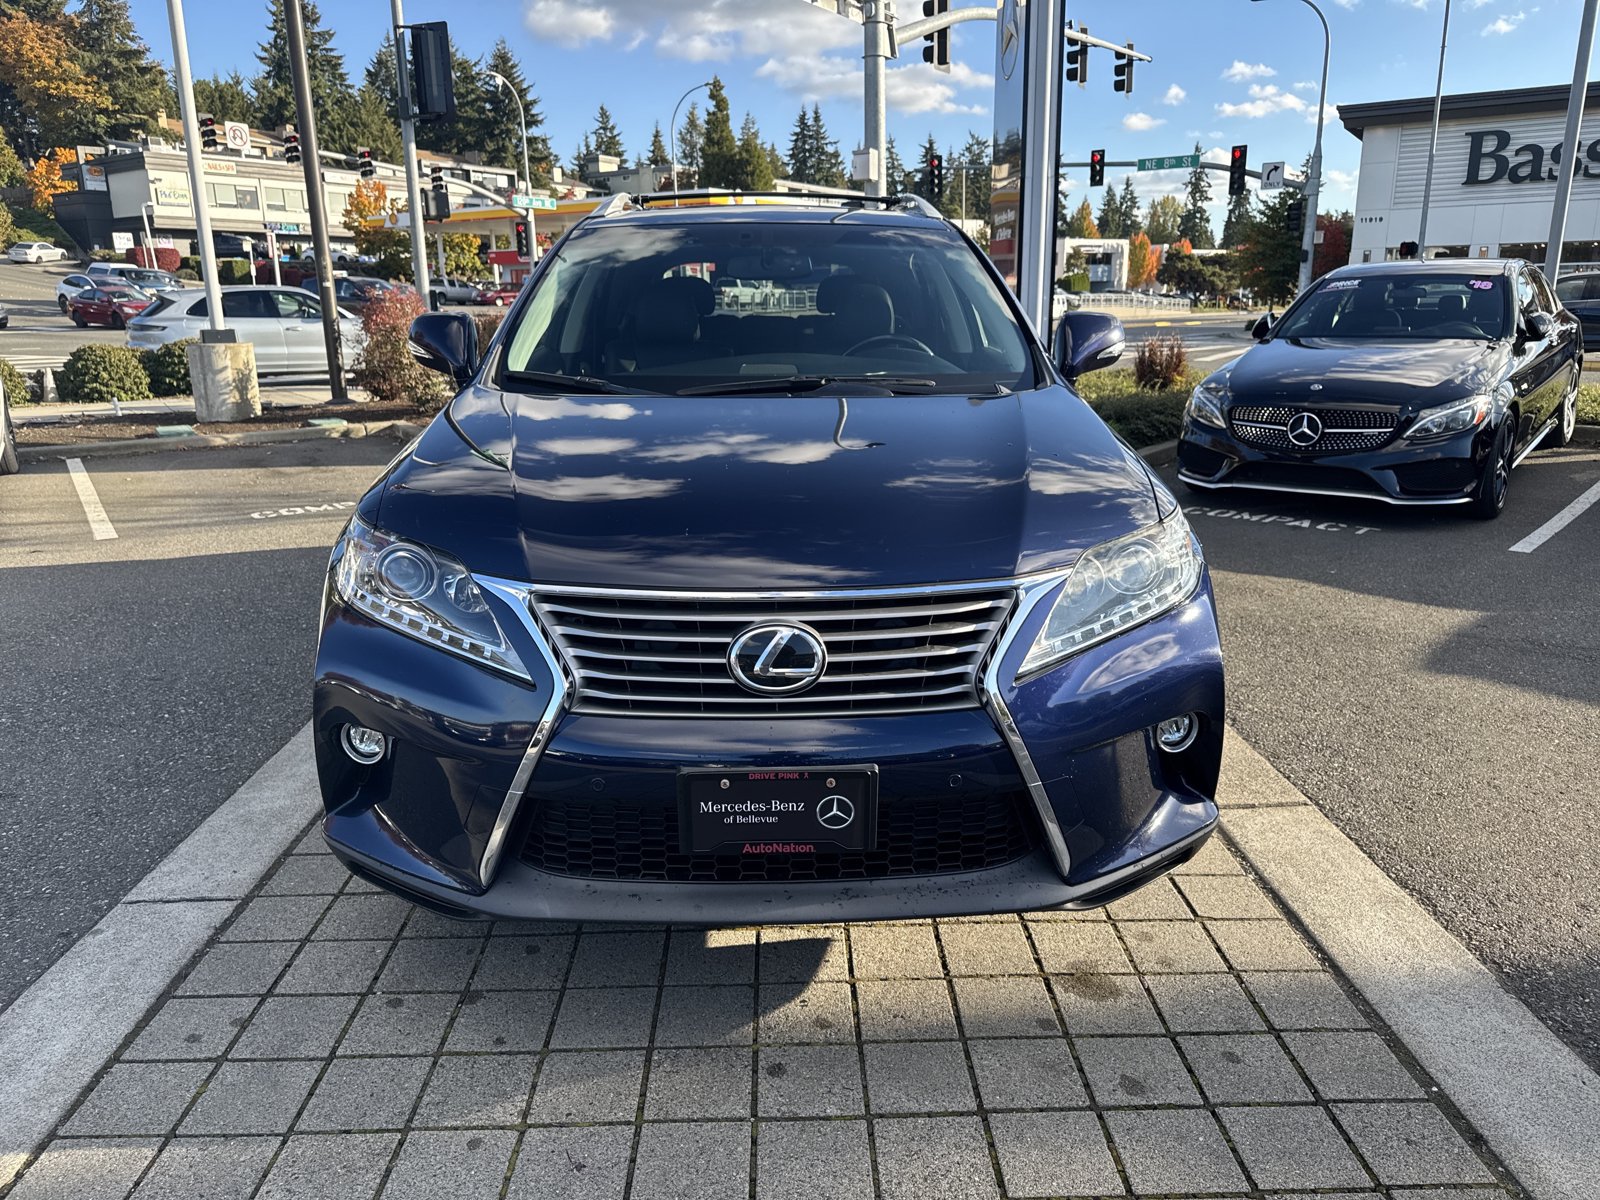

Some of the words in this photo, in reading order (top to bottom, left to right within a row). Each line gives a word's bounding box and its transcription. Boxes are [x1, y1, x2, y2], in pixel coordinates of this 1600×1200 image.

[1145, 160, 1157, 169] NE
[1163, 158, 1176, 168] 8th
[1182, 156, 1191, 166] St
[1183, 506, 1381, 535] COMPACT
[700, 800, 805, 813] Mercedes-Benz
[724, 815, 734, 823] of
[736, 815, 778, 823] Bellevue
[743, 843, 816, 853] AutoNation
